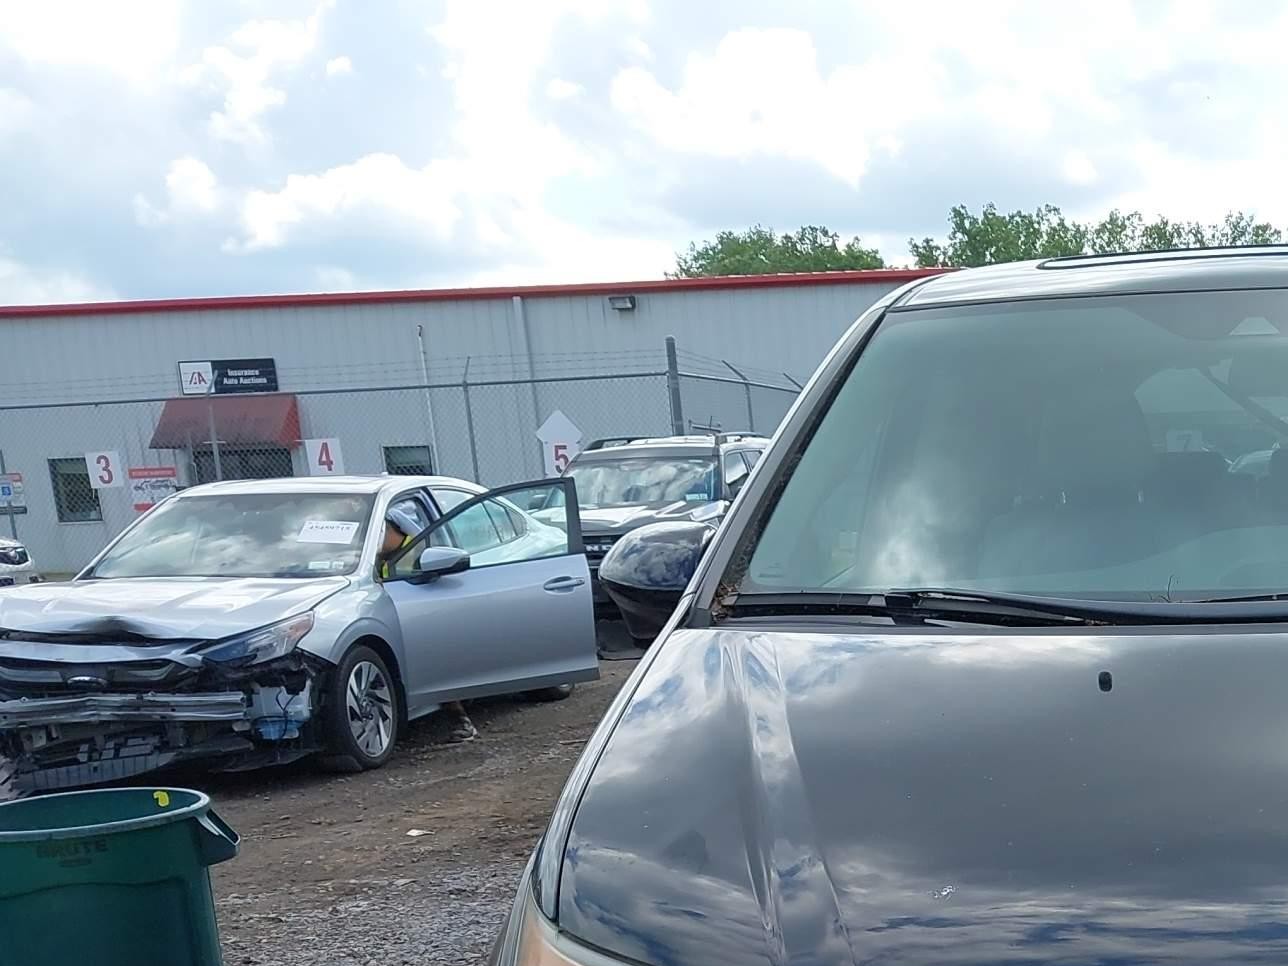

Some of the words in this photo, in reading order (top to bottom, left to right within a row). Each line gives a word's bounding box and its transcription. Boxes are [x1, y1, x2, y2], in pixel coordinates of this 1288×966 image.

[223, 377, 239, 385] Auto
[239, 376, 268, 385] Auctions
[227, 367, 260, 377] Insurance
[96, 455, 114, 485] 3
[317, 441, 334, 472] 4
[554, 445, 569, 474] 5
